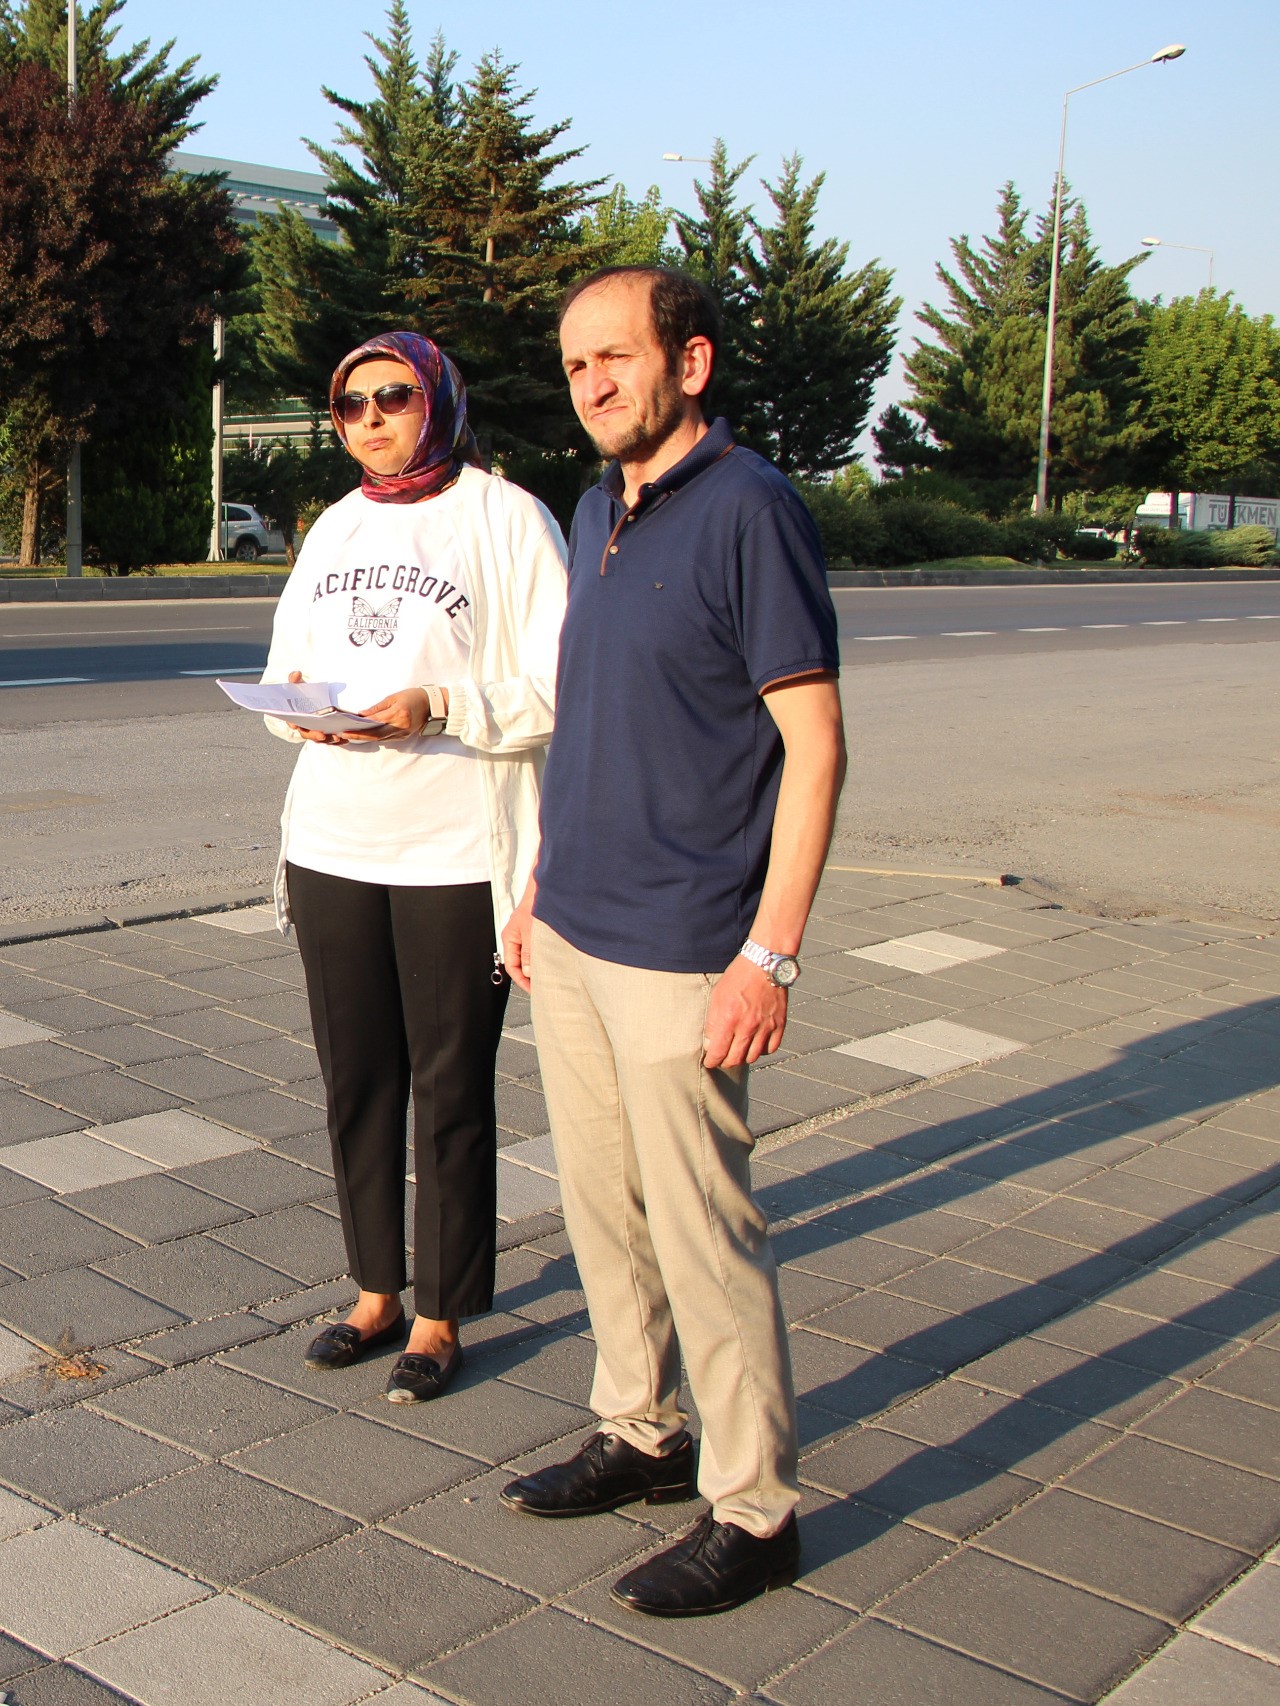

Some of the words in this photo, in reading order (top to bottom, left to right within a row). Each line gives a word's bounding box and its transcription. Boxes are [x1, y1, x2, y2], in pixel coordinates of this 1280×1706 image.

[1208, 503, 1277, 526] TÜKMEN
[392, 565, 469, 619] GROVE
[347, 617, 398, 629] CALIFORNIA
